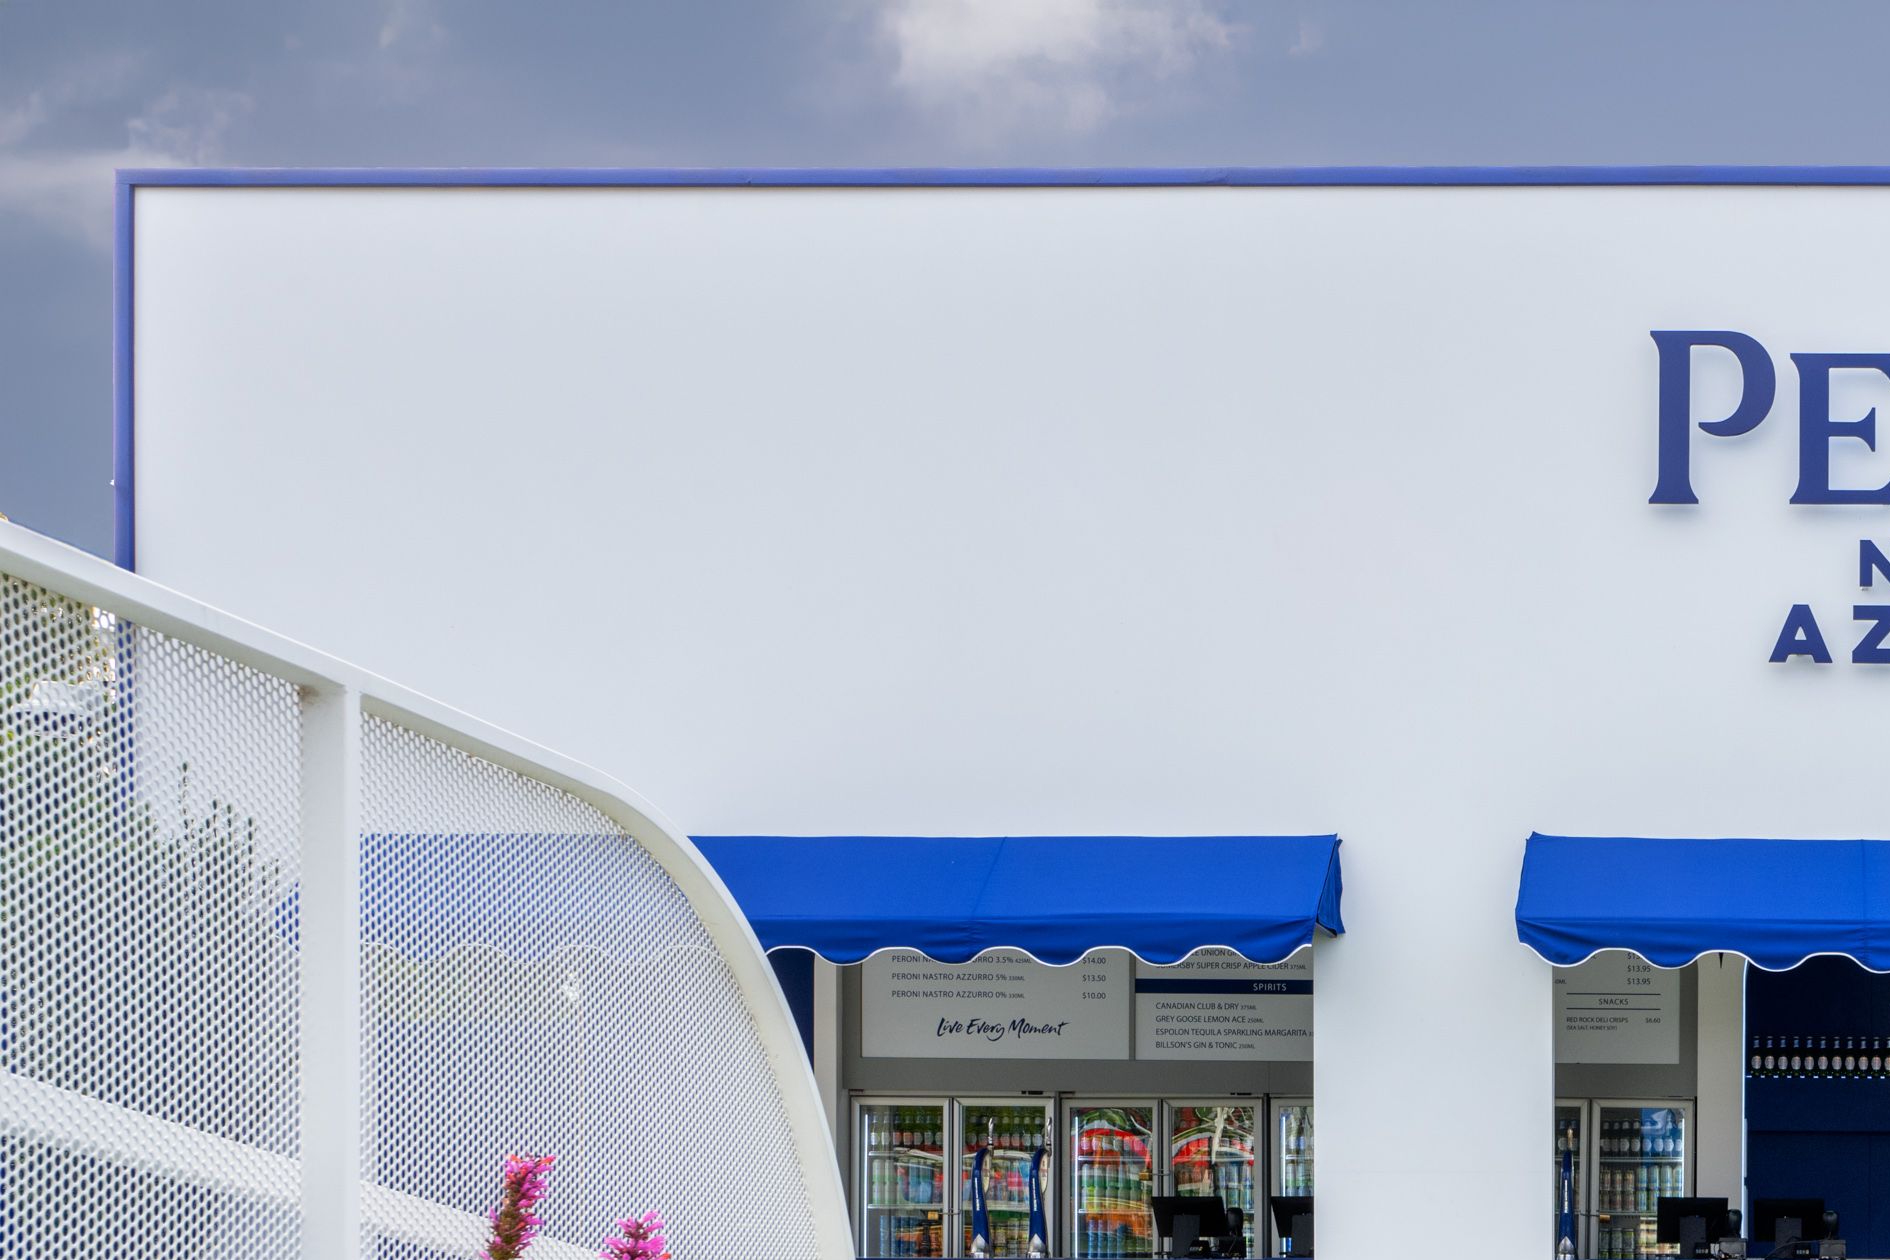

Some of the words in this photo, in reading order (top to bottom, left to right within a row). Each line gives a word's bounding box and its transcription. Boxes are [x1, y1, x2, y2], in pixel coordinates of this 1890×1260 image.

[892, 955, 920, 963] PERONI
[1082, 956, 1106, 965] $14.00
[1243, 962, 1265, 970] APPLE
[1627, 965, 1651, 973] $13.95
[892, 973, 920, 981] PERONI
[923, 973, 954, 981] NASTRO
[956, 973, 994, 981] AZZURRO
[996, 973, 1007, 981] 5%
[1082, 974, 1106, 982] $13.50
[1253, 983, 1287, 991] SPIRITS
[892, 990, 920, 998] PERONI
[922, 990, 954, 998] NASTRO
[956, 991, 994, 999] AZZURRO
[995, 991, 1007, 999] 0%
[1082, 992, 1106, 1000] $10.00
[1156, 1002, 1196, 1010] CANADIAN
[1197, 1002, 1216, 1010] CLUB
[1599, 998, 1629, 1006] SNACKS
[1156, 1015, 1175, 1023] GREY
[1232, 1016, 1246, 1024] ACE
[937, 1018, 963, 1037] Live
[966, 1018, 1005, 1042] Every
[1008, 1018, 1069, 1039] Moment
[1156, 1028, 1190, 1036] ESPOLON
[1191, 1028, 1222, 1037] TEQUILA
[1224, 1029, 1263, 1037] SPARKLING
[1265, 1029, 1307, 1037] MARGARITA
[1156, 1041, 1192, 1049] BILLSON'S
[1194, 1041, 1207, 1049] GIN
